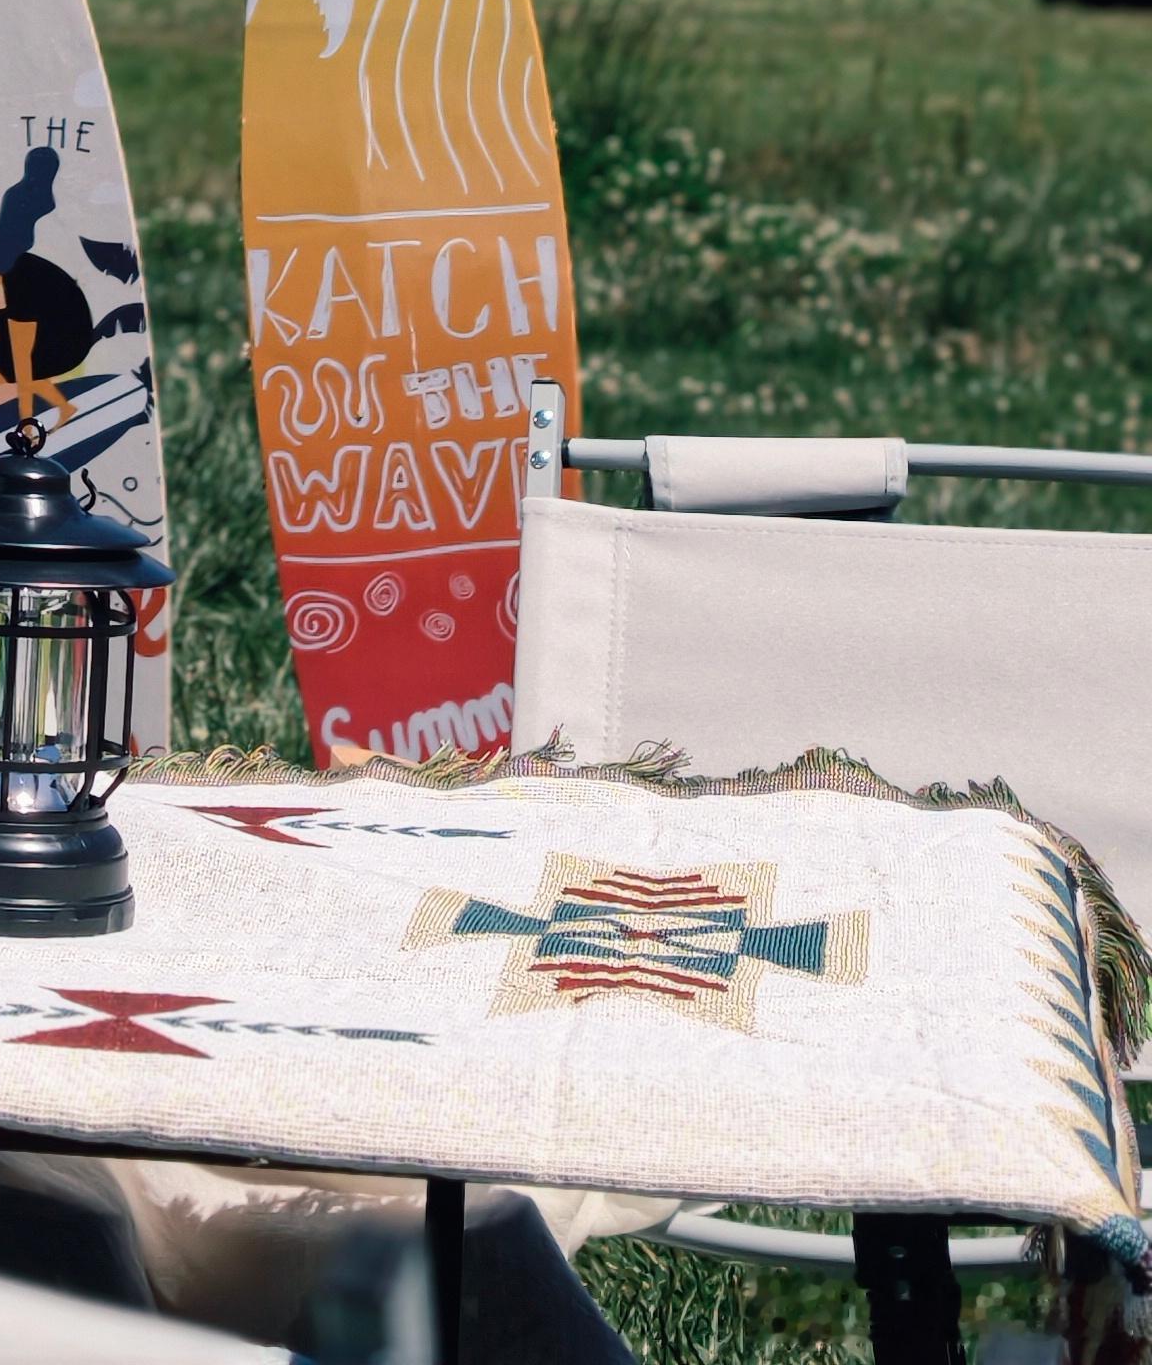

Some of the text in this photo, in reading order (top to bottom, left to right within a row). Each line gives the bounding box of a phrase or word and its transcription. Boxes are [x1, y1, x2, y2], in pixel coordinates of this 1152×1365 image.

[20, 116, 96, 153] THE
[248, 235, 558, 348] KATCH
[269, 437, 525, 532] WAV
